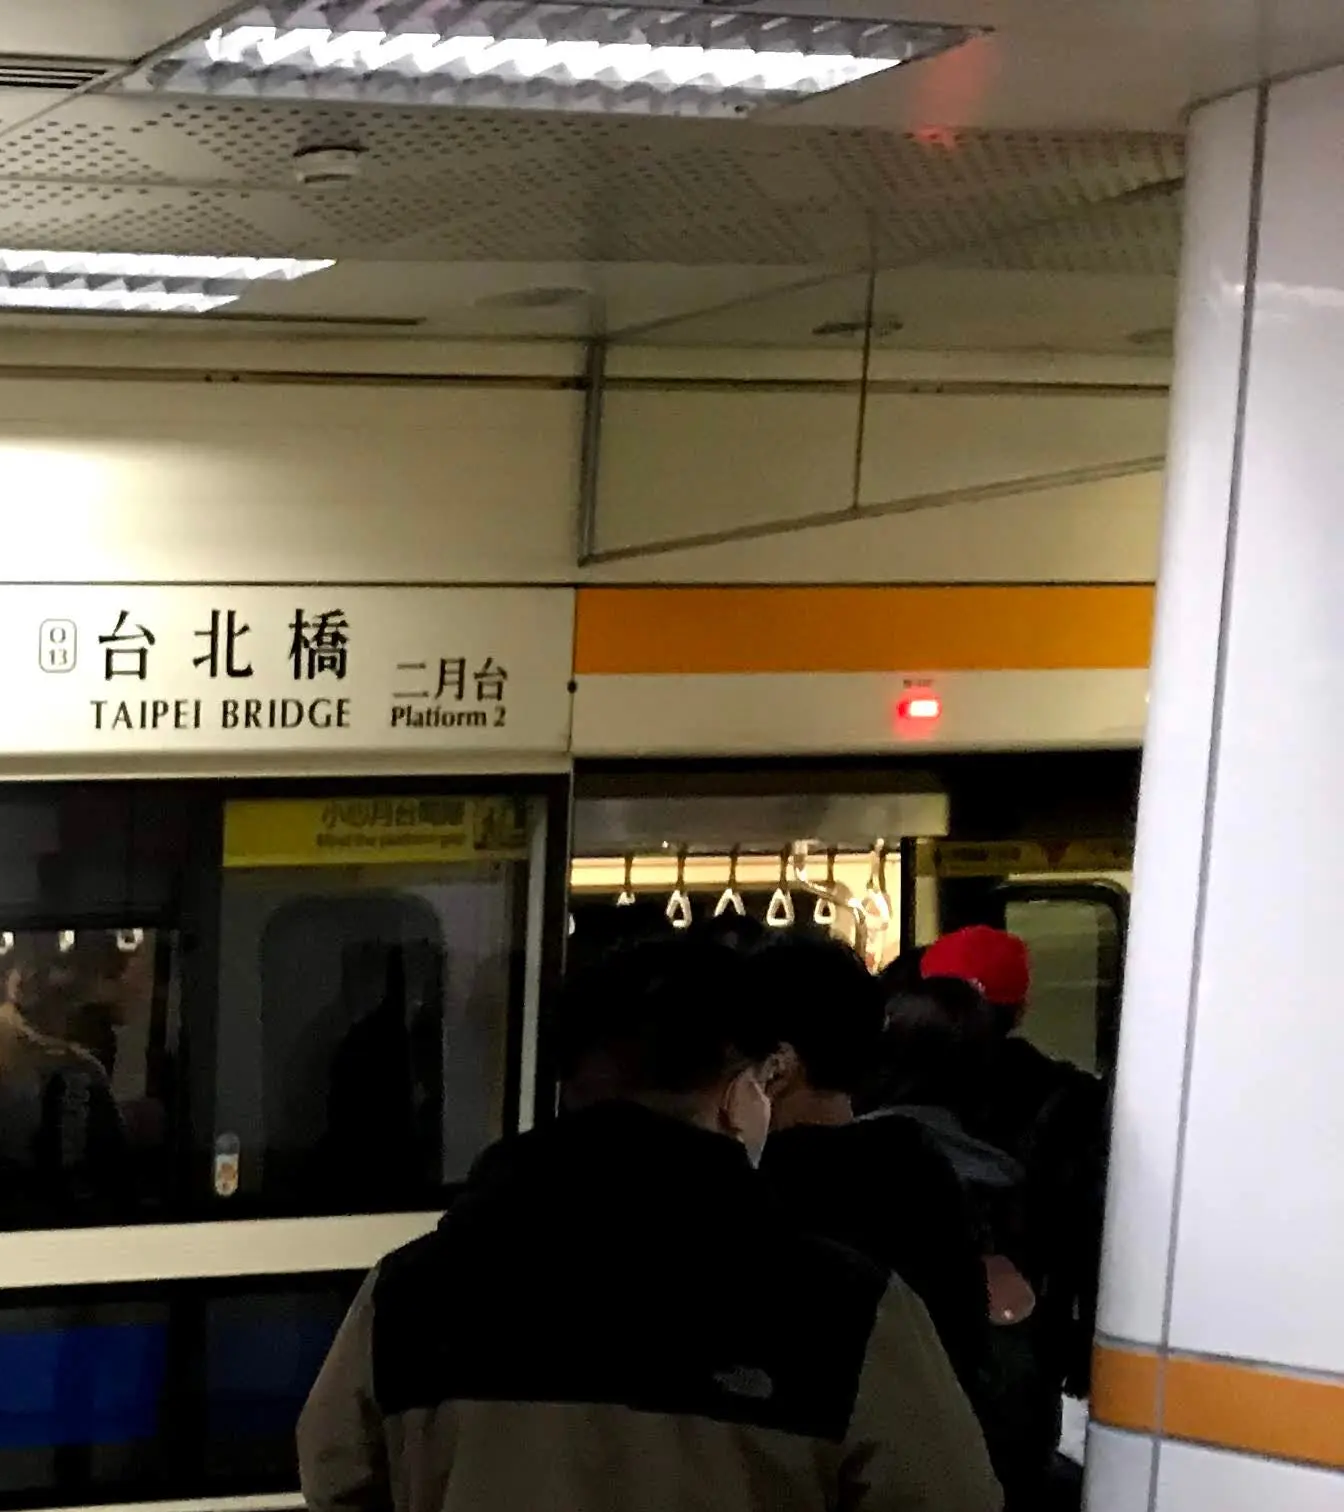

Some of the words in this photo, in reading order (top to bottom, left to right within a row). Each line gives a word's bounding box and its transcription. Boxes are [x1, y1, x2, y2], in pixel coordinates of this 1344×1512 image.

[49, 648, 68, 666] 13
[98, 608, 350, 680] 台北橋
[392, 656, 509, 702] 二月台
[89, 698, 202, 730] TAIPEI
[221, 698, 352, 729] BRIDGE
[390, 703, 487, 727] Platform
[493, 704, 507, 727] 2
